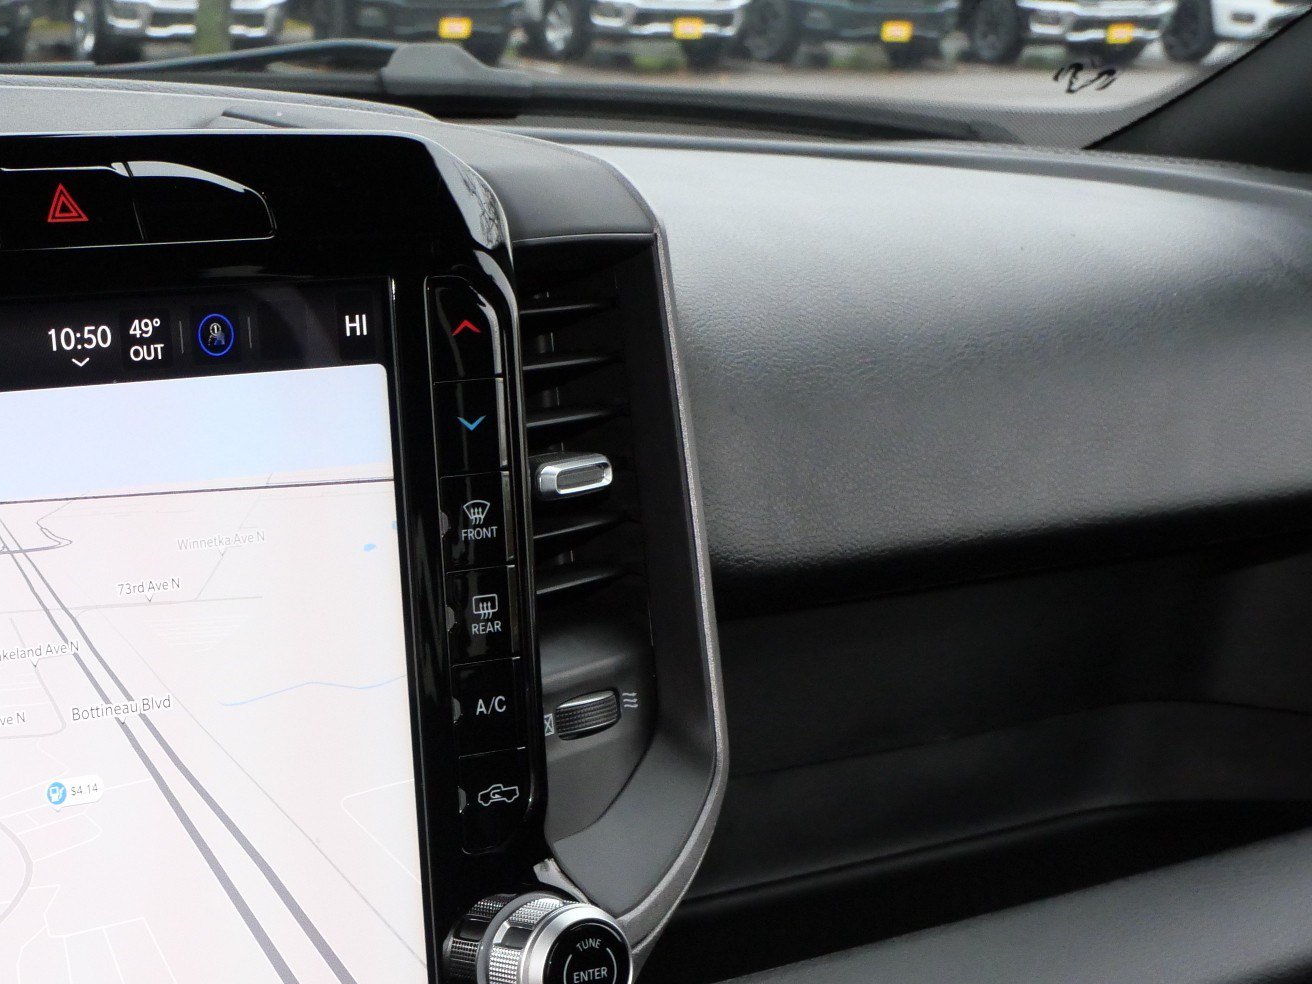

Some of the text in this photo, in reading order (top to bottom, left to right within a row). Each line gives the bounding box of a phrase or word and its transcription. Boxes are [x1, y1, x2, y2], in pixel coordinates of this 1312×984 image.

[129, 317, 161, 339] 49°
[345, 313, 368, 337] HI
[47, 325, 112, 352] 10:50
[129, 343, 165, 362] OUT
[177, 530, 265, 551] Winnetka Ave N
[461, 526, 499, 542] FRONT
[117, 577, 180, 596] 73rd Ave N
[471, 620, 502, 636] REAR
[45, 642, 69, 657] Ave
[69, 640, 79, 653] N
[72, 694, 171, 722] Bottineau Blvd
[475, 695, 507, 716] A/C
[16, 712, 26, 725] N
[70, 781, 99, 797] $4.14
[576, 938, 602, 952] TUNE
[573, 966, 608, 984] ENTER
